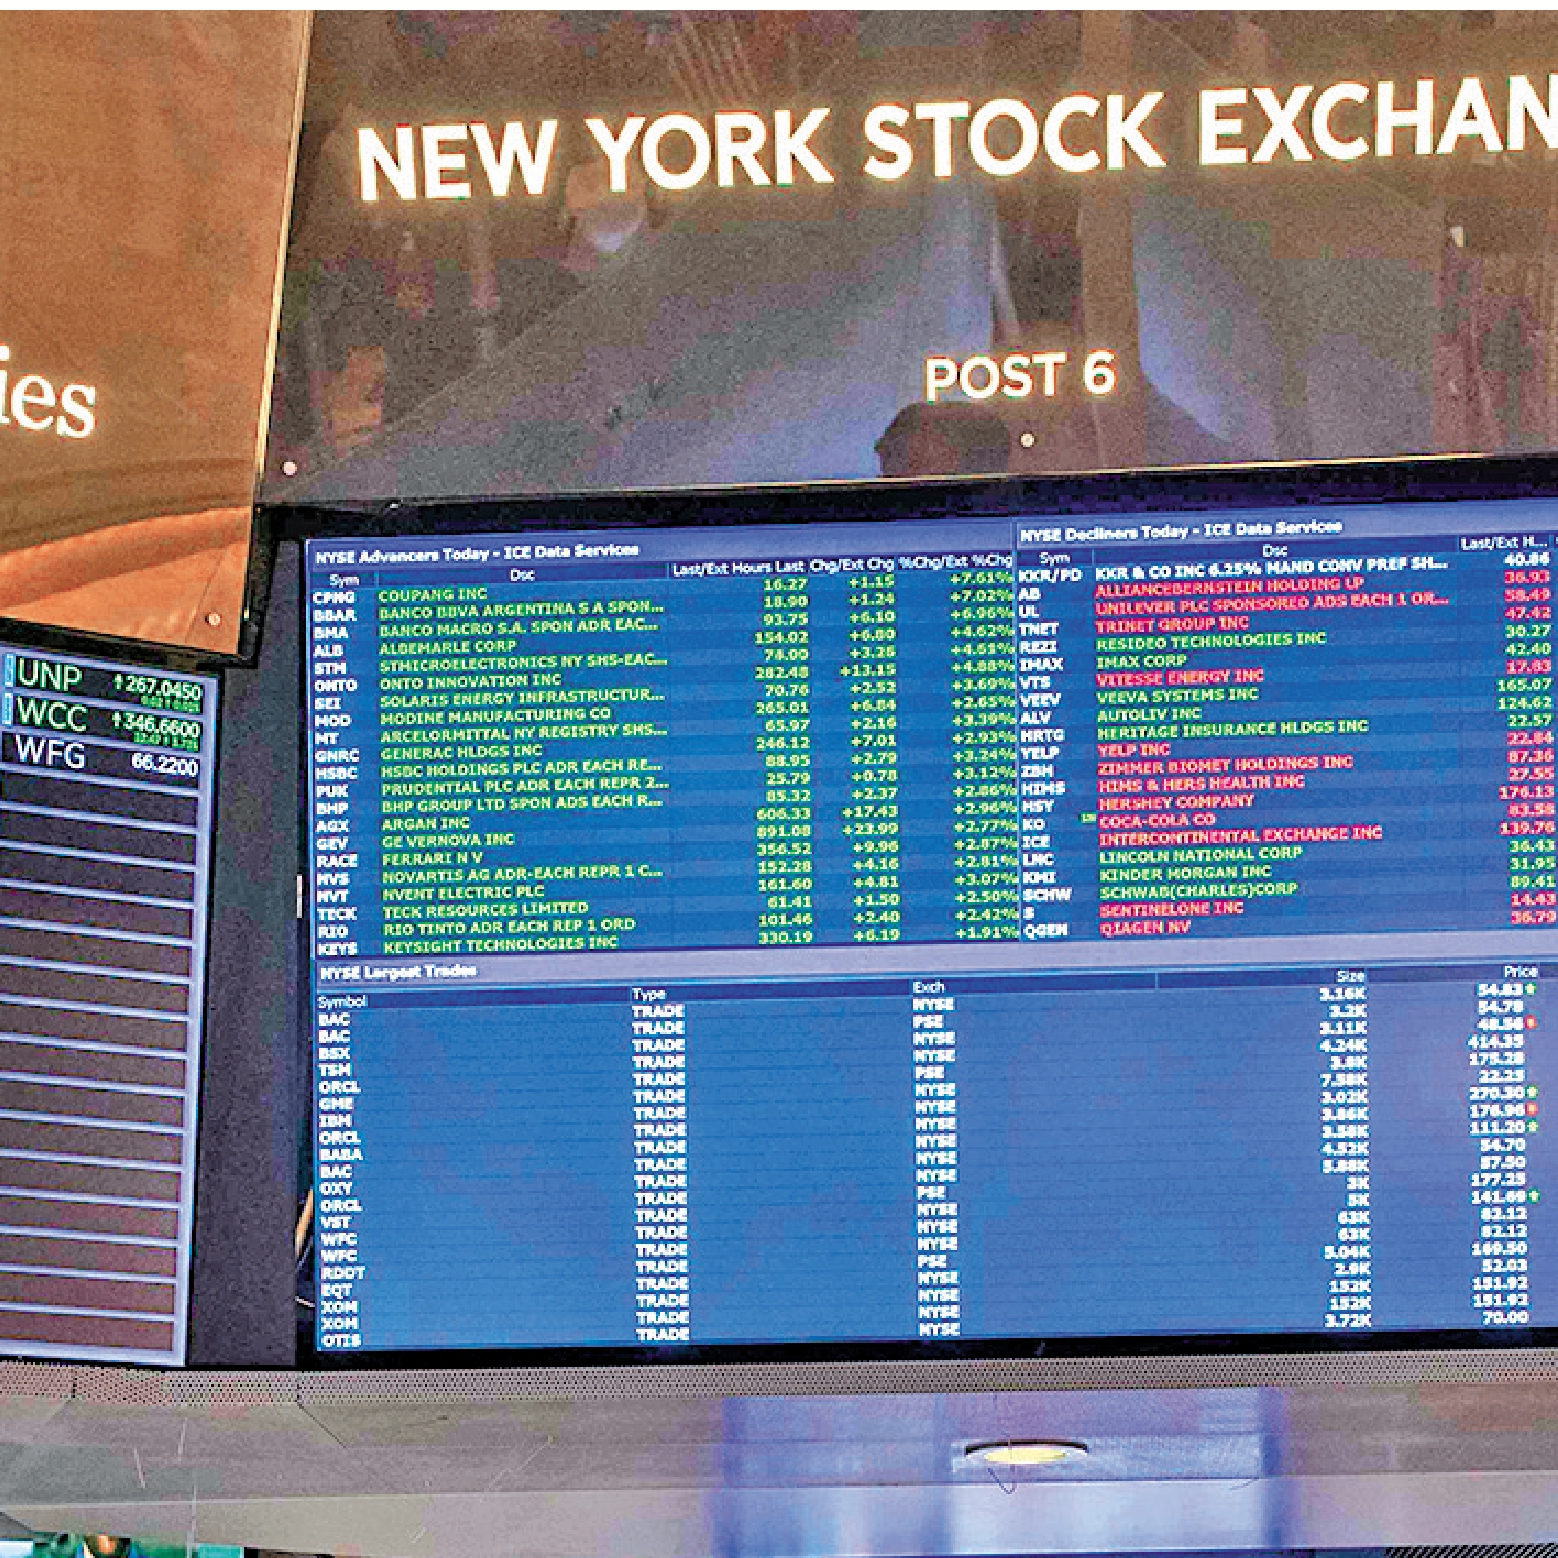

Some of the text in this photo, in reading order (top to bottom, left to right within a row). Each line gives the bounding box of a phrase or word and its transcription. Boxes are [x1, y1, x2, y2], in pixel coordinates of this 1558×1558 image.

[356, 121, 556, 201] NEW
[588, 108, 833, 193] YORK
[863, 91, 1166, 182] STOCK
[924, 352, 1116, 400] POST 6
[1020, 520, 1342, 541] NYSE Decliners Today ICE Data Services
[316, 544, 640, 563] NYSE Advancers Today ICE Data Services
[378, 588, 488, 601] COUPANG INC
[17, 658, 202, 699] UNP 267.0450
[14, 734, 199, 777] WFG 66.2200
[1098, 813, 1216, 828] COCA-COLA CO
[316, 855, 358, 868] RACE
[383, 853, 451, 865] FERRARI
[466, 938, 584, 953] TECHNOLOGIES
[588, 935, 618, 948] INC
[320, 963, 478, 982] NYSE Largest Trades
[318, 996, 367, 1010] Symbol
[631, 987, 666, 1001] Type
[1337, 970, 1365, 983] Size
[1504, 965, 1538, 979] Price
[632, 1004, 684, 1018] TRADE
